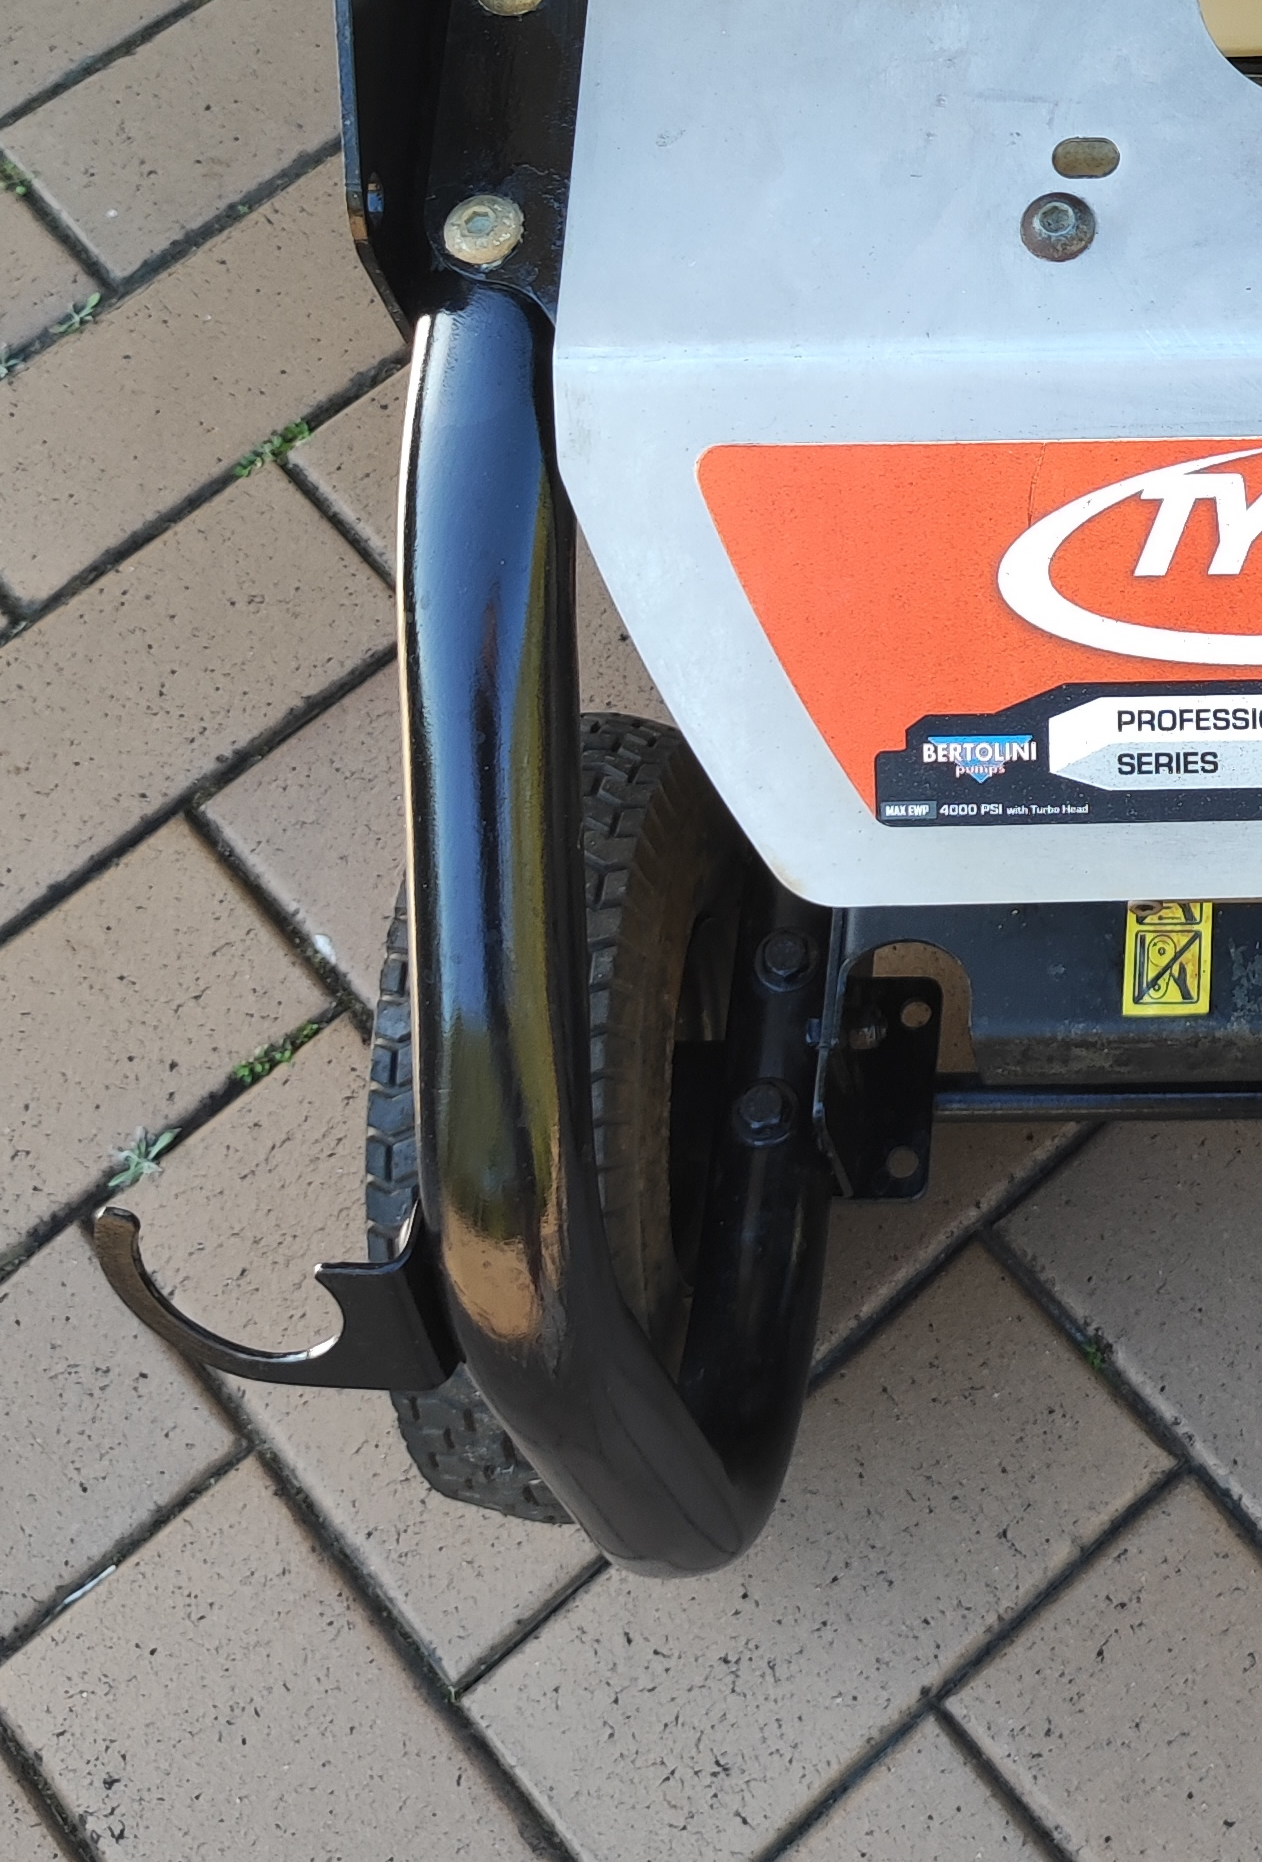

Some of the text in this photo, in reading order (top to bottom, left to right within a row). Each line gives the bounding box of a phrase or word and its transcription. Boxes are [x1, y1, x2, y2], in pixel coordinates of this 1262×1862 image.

[922, 741, 1037, 763] BERTOLINI
[955, 764, 1006, 778] pumps
[1117, 751, 1219, 776] SERIES
[885, 802, 1089, 816] MAX EWP 4000 PSI with Turbo Head
